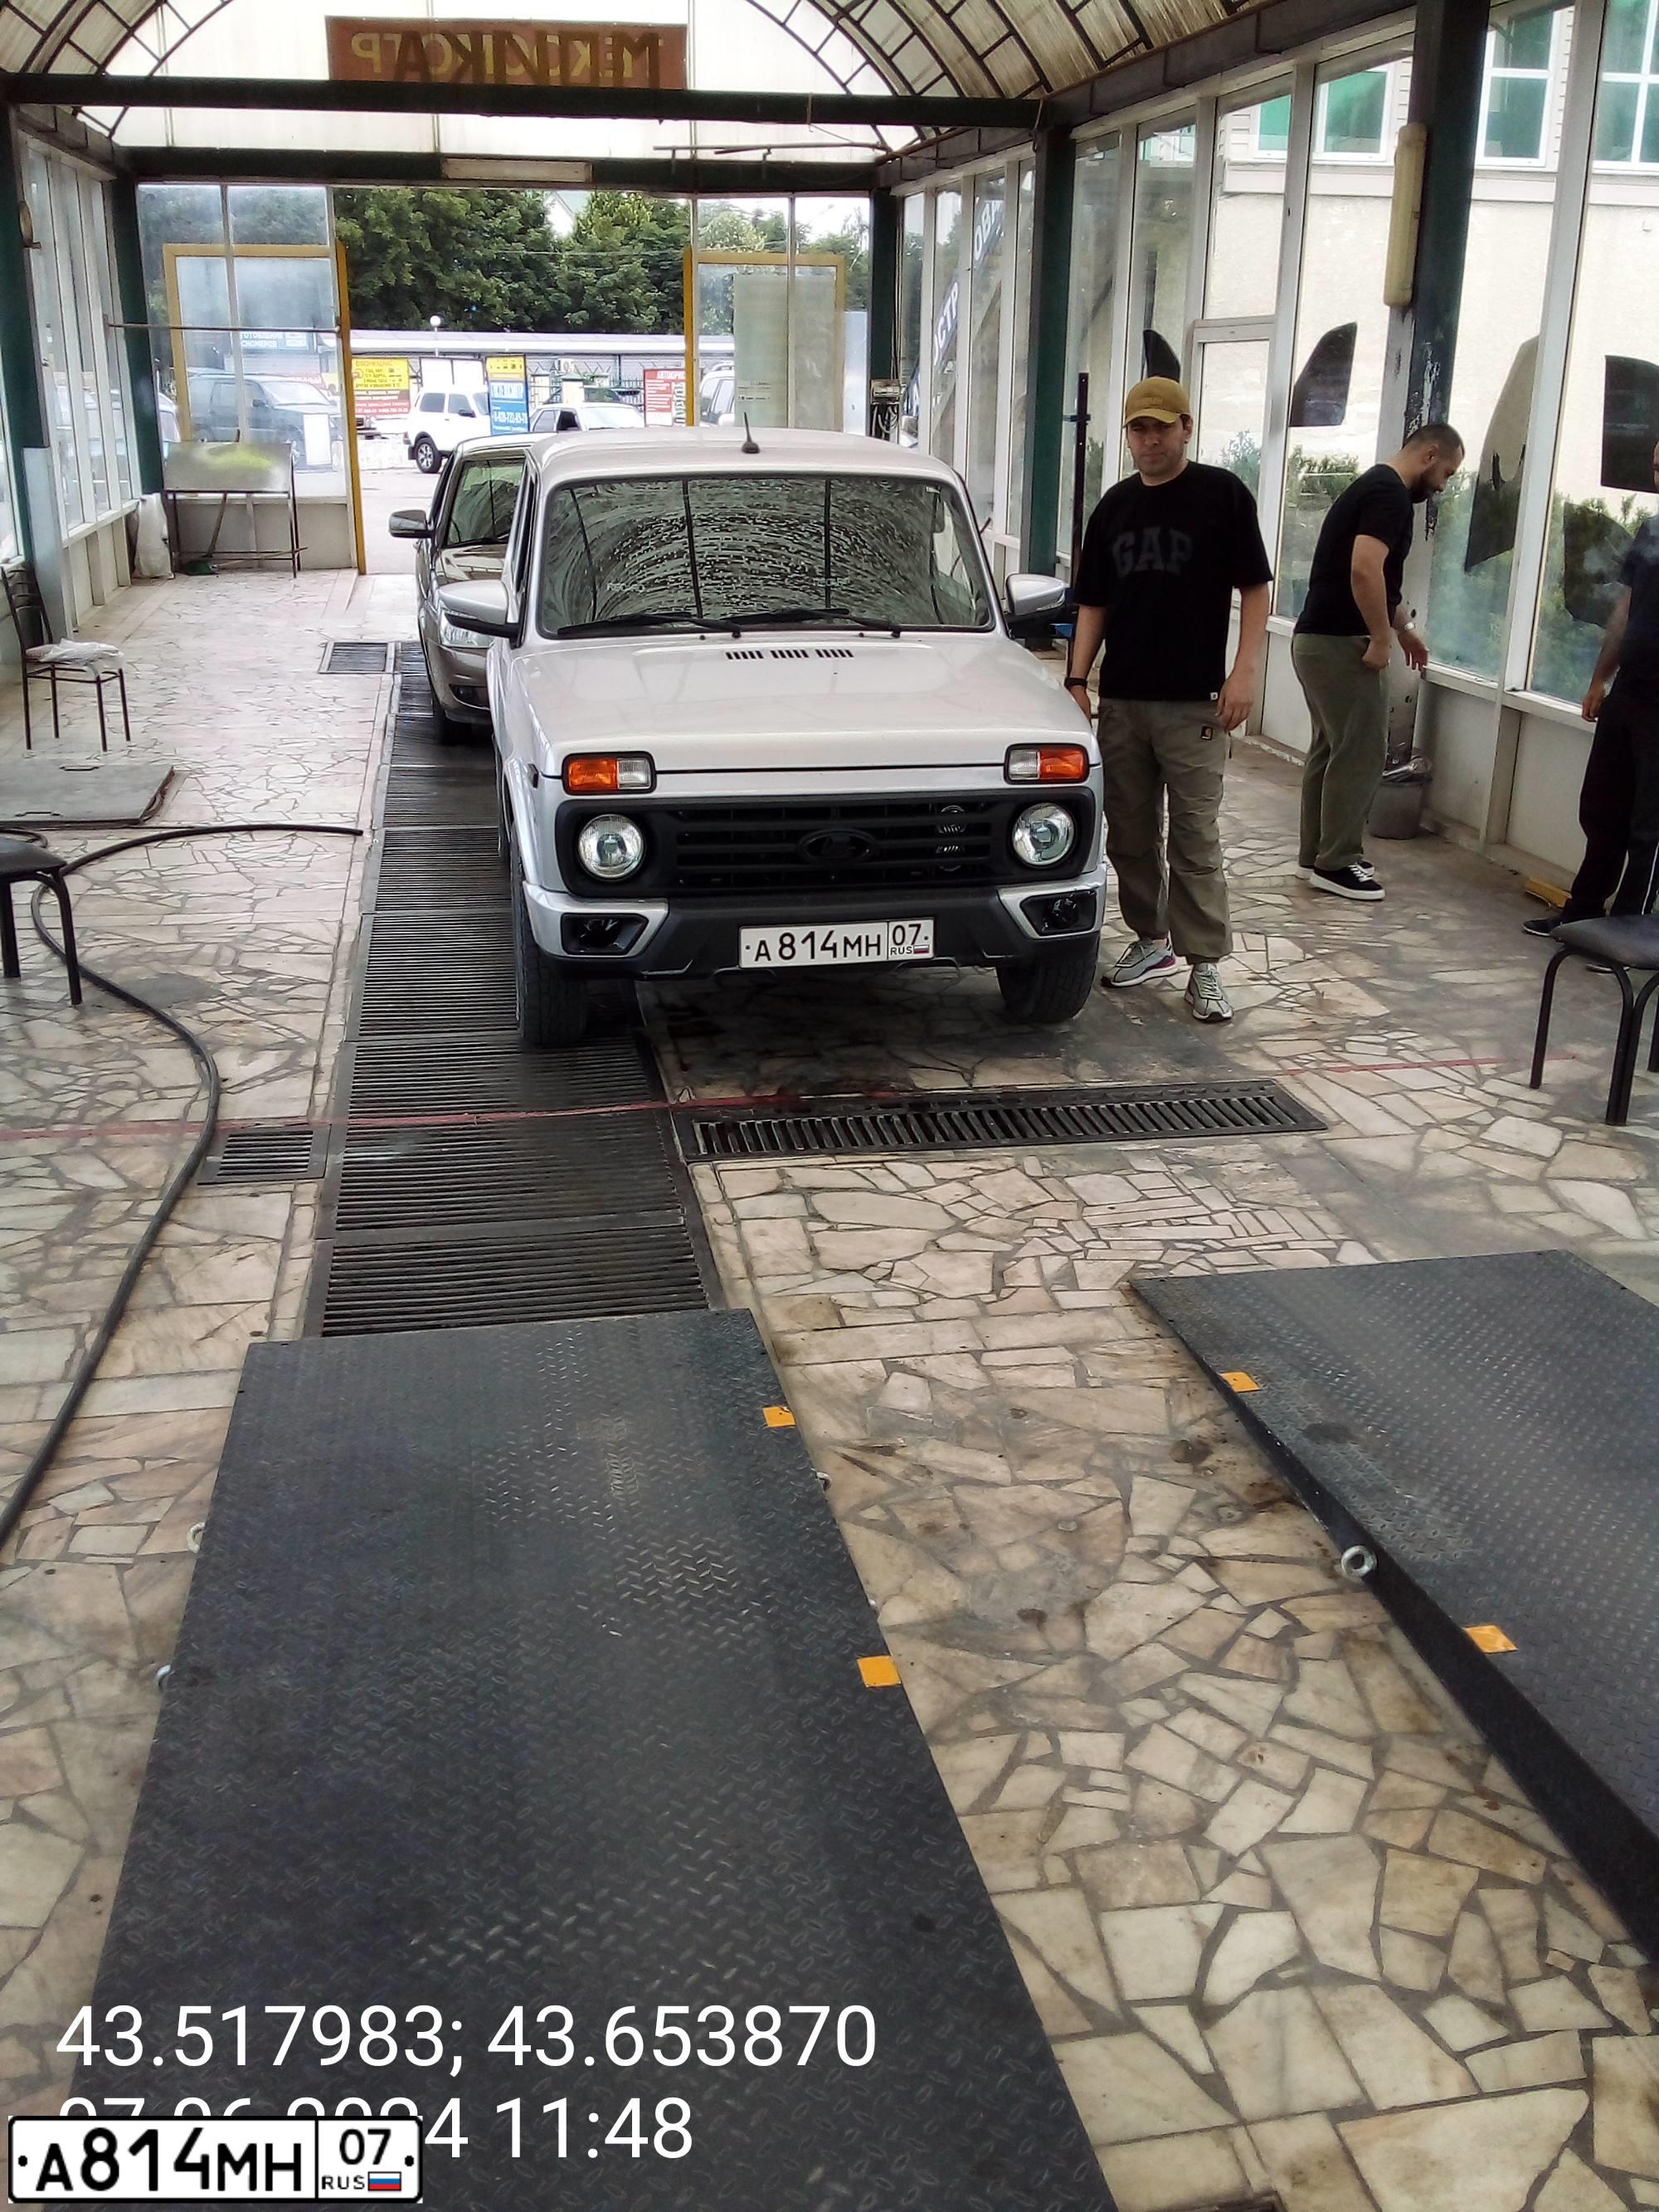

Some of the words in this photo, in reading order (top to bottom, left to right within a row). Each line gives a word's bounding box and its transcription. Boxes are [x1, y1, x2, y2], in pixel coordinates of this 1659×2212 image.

[1112, 526, 1193, 578] GAP
[754, 930, 881, 962] А814МН
[892, 923, 922, 946] 07
[890, 946, 912, 956] RUS
